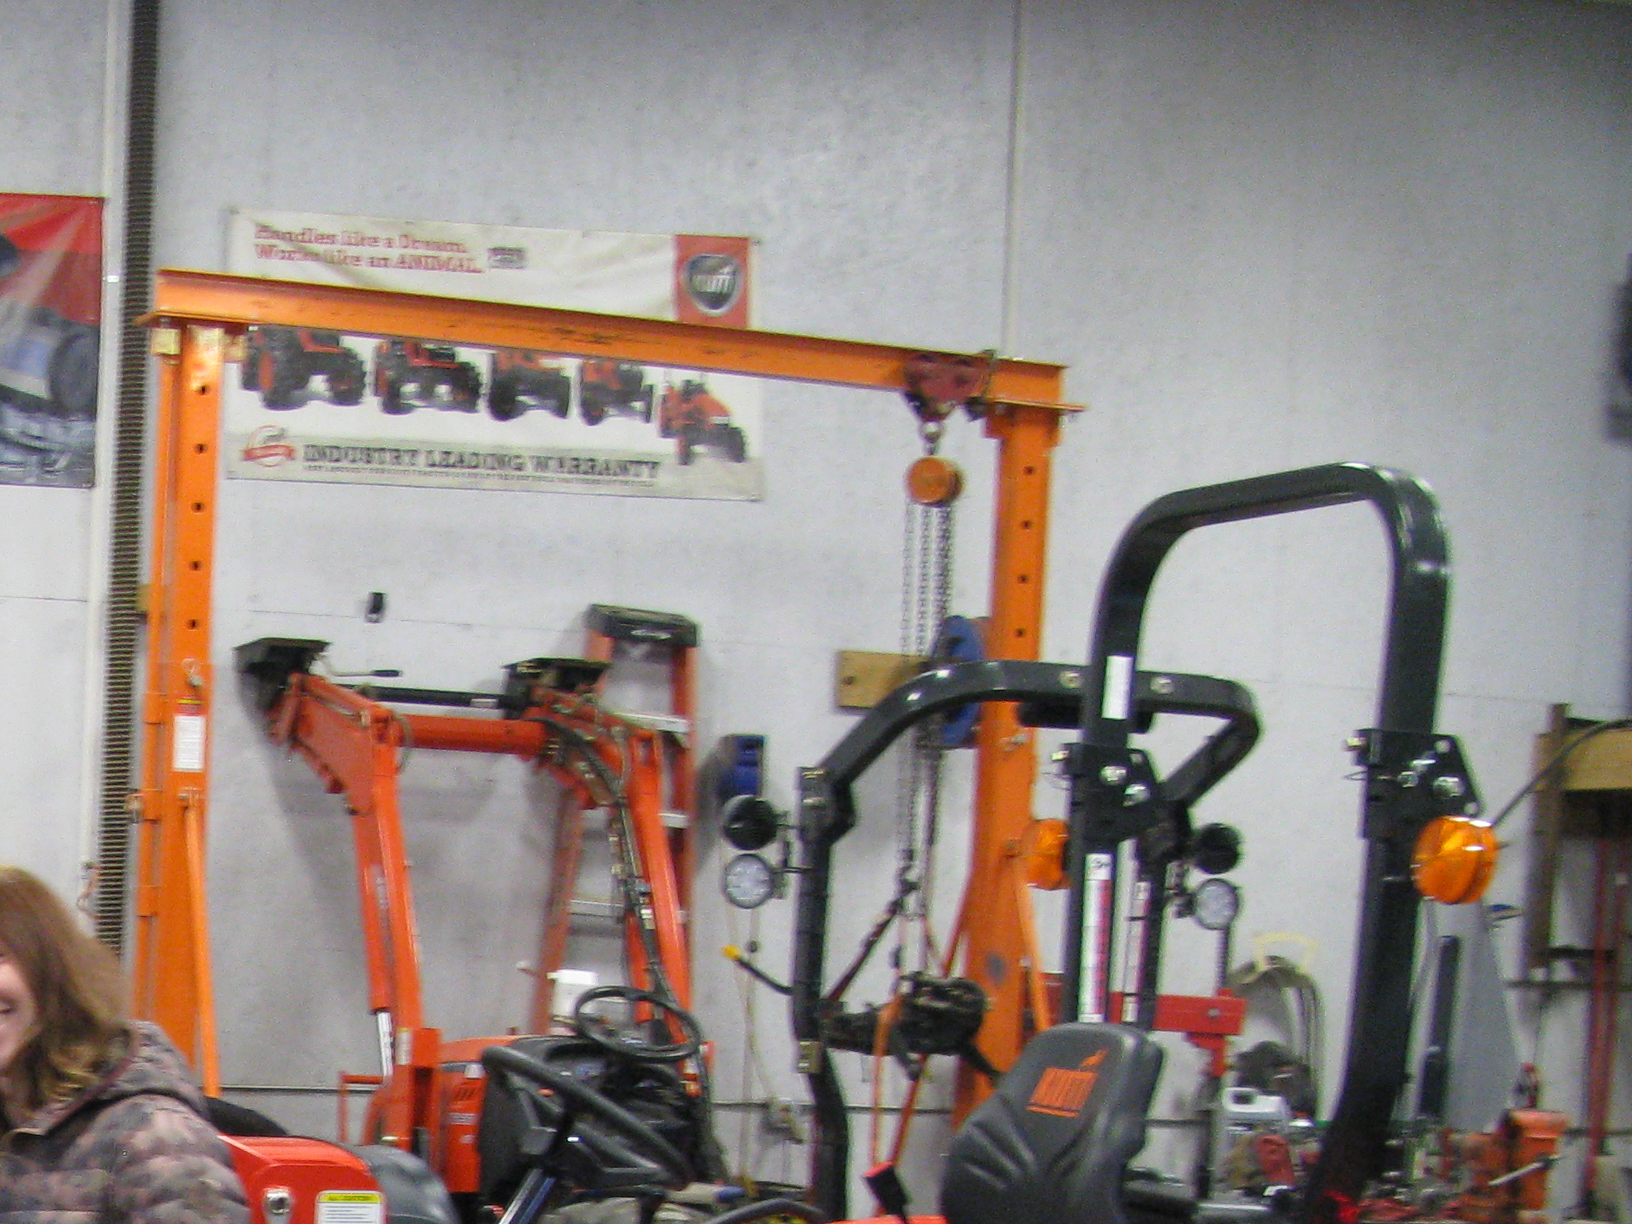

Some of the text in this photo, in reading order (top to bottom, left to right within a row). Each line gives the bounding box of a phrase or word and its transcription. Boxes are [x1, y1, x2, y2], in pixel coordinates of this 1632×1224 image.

[340, 230, 381, 248] like
[303, 444, 419, 468] INDUSTRY
[424, 450, 524, 472] LEADING
[529, 455, 661, 479] WARRANTY
